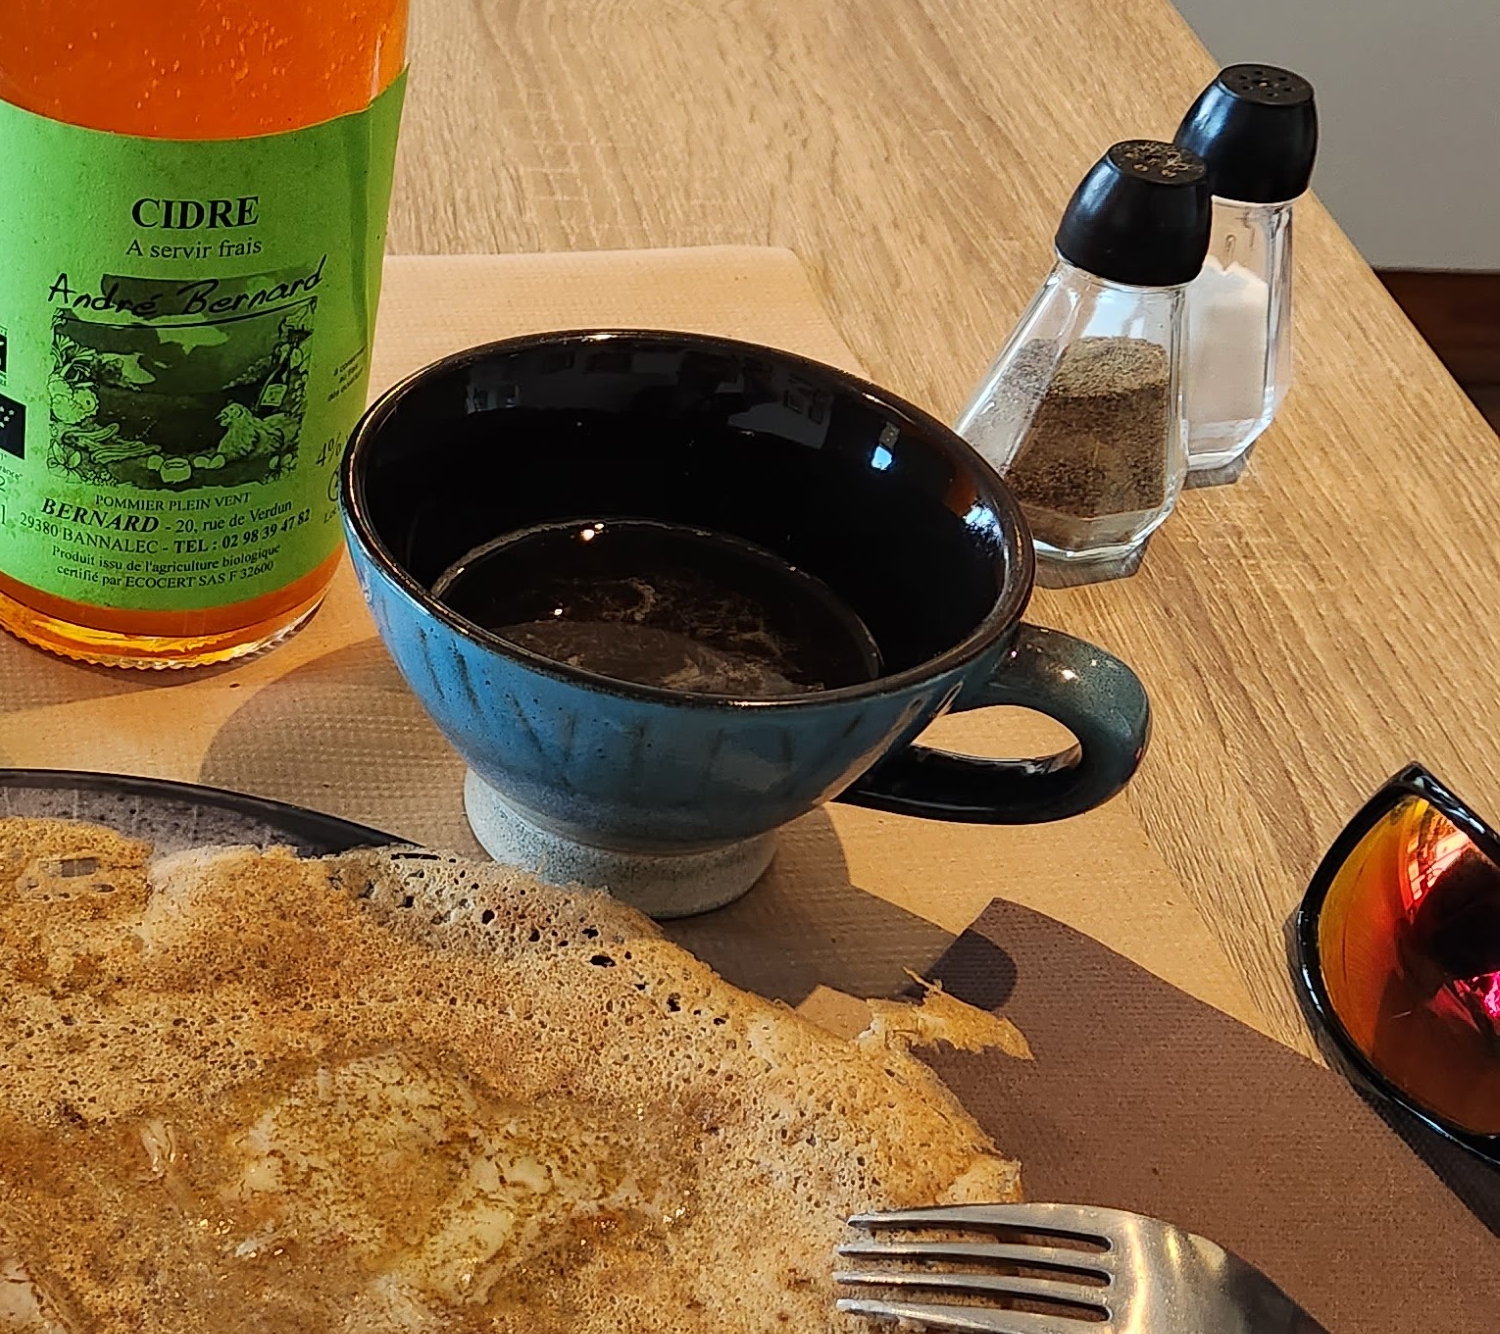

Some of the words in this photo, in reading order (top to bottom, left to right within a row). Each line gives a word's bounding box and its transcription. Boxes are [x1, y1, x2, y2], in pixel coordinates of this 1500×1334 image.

[131, 195, 260, 230] CIDRE
[125, 239, 144, 257] A
[150, 241, 212, 260] servir
[218, 236, 263, 258] frais
[48, 272, 164, 317] André
[176, 254, 328, 316] Bernard
[41, 497, 160, 534] BERNARD
[175, 519, 198, 535] 20,
[202, 518, 226, 532] rue
[229, 513, 245, 529] de
[249, 500, 292, 523] Verdun
[95, 494, 164, 511] POMMIER
[168, 495, 210, 511] PLEIN
[214, 491, 251, 509] VENT
[20, 512, 59, 538] 29380
[62, 529, 159, 555] BANNALEC
[173, 540, 208, 555] TEL
[222, 535, 239, 550] 02
[243, 529, 259, 545] 98
[261, 524, 278, 540] 39
[281, 516, 296, 533] 47
[297, 508, 311, 527] 82
[52, 545, 96, 567] Produit
[99, 557, 123, 571] issu
[126, 560, 142, 572] de
[145, 560, 220, 576] l'agriculture
[222, 545, 281, 569] biologique
[57, 565, 100, 583] certifié
[102, 574, 122, 587] par
[125, 575, 196, 589] ECOCERT
[199, 572, 225, 587] SAS
[229, 571, 237, 584] F
[240, 561, 274, 580] 32600
